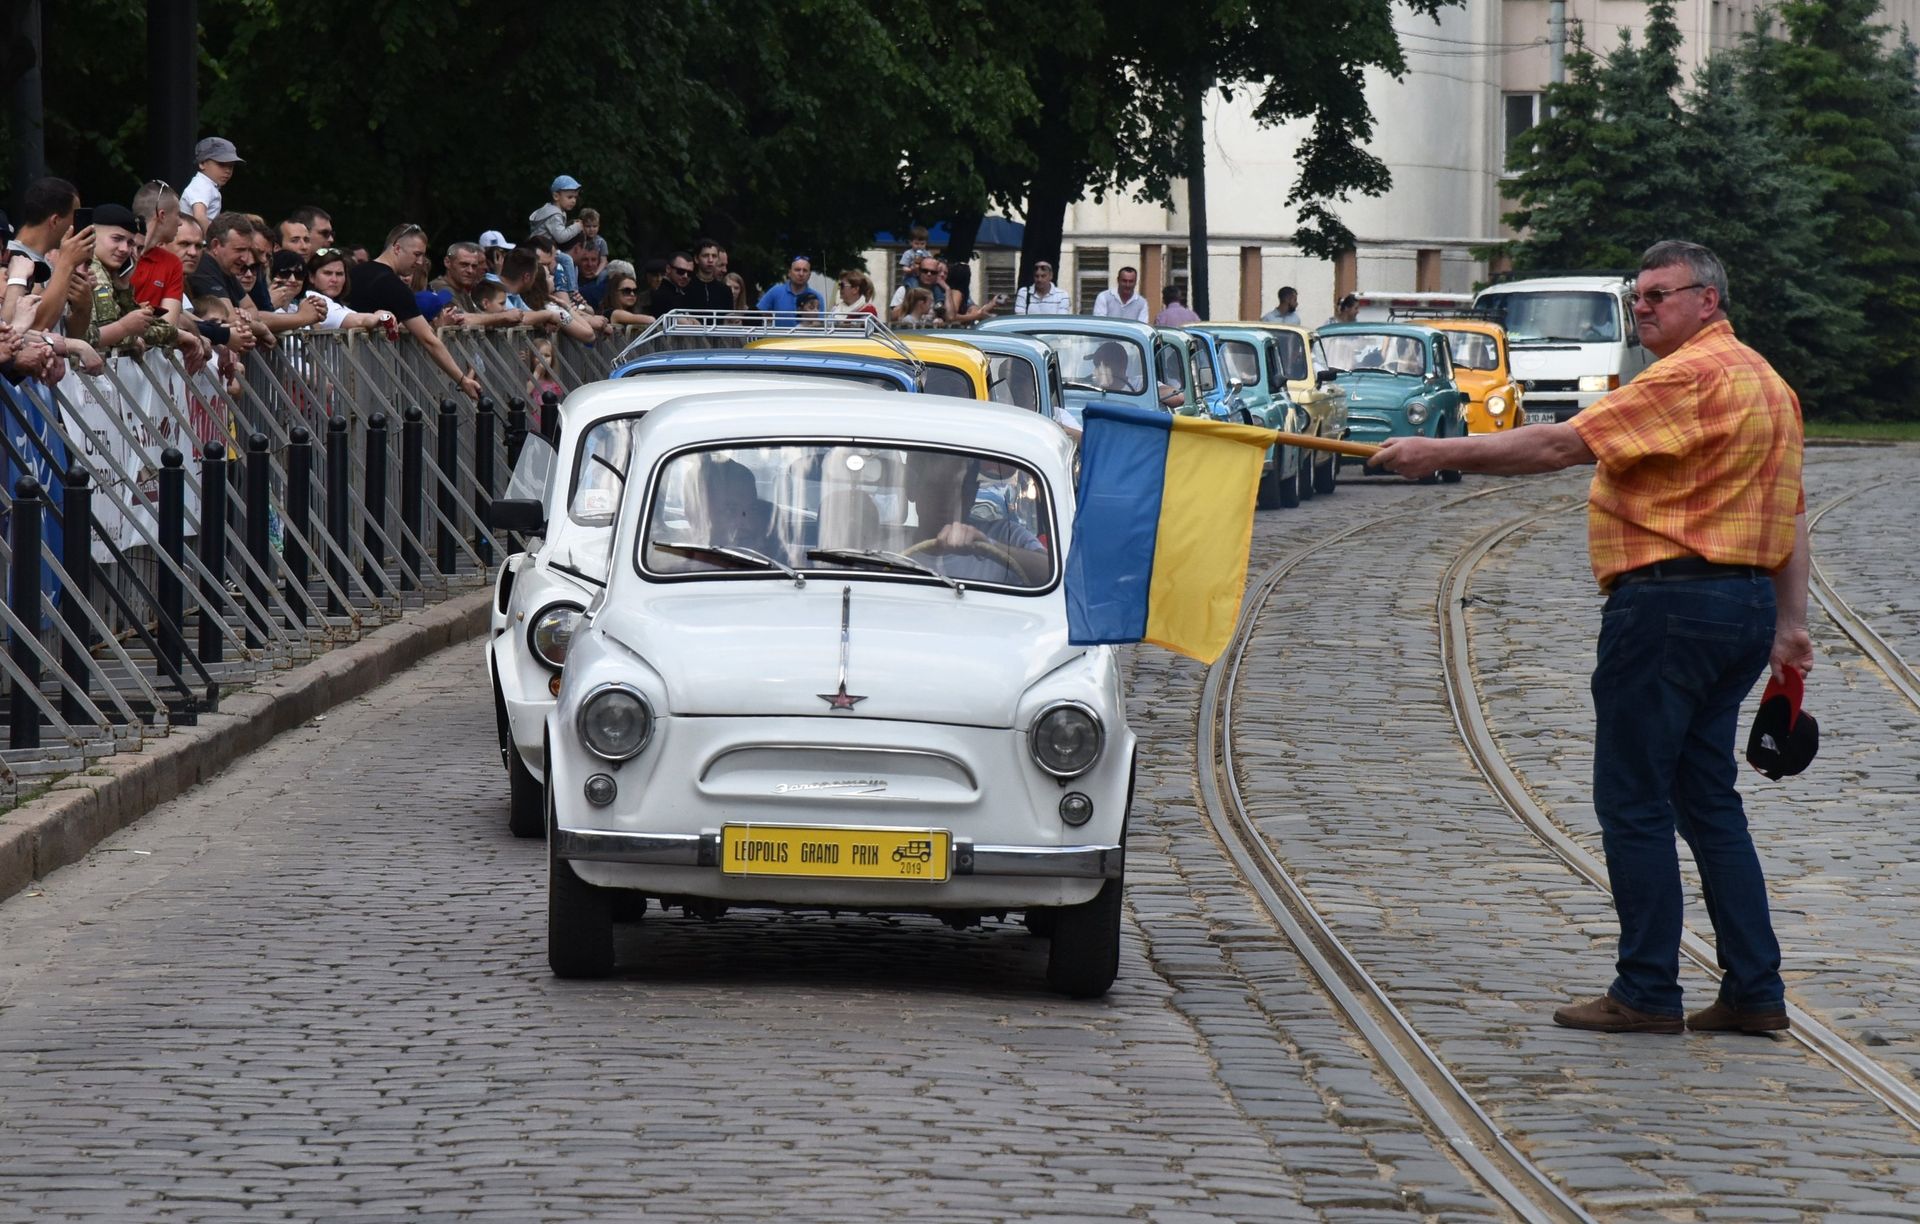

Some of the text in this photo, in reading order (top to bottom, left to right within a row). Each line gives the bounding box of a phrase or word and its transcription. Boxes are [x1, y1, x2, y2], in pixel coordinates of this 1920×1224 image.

[735, 840, 879, 865] LEOPOLIS GRAND PRIX
[900, 861, 922, 875] 2019
